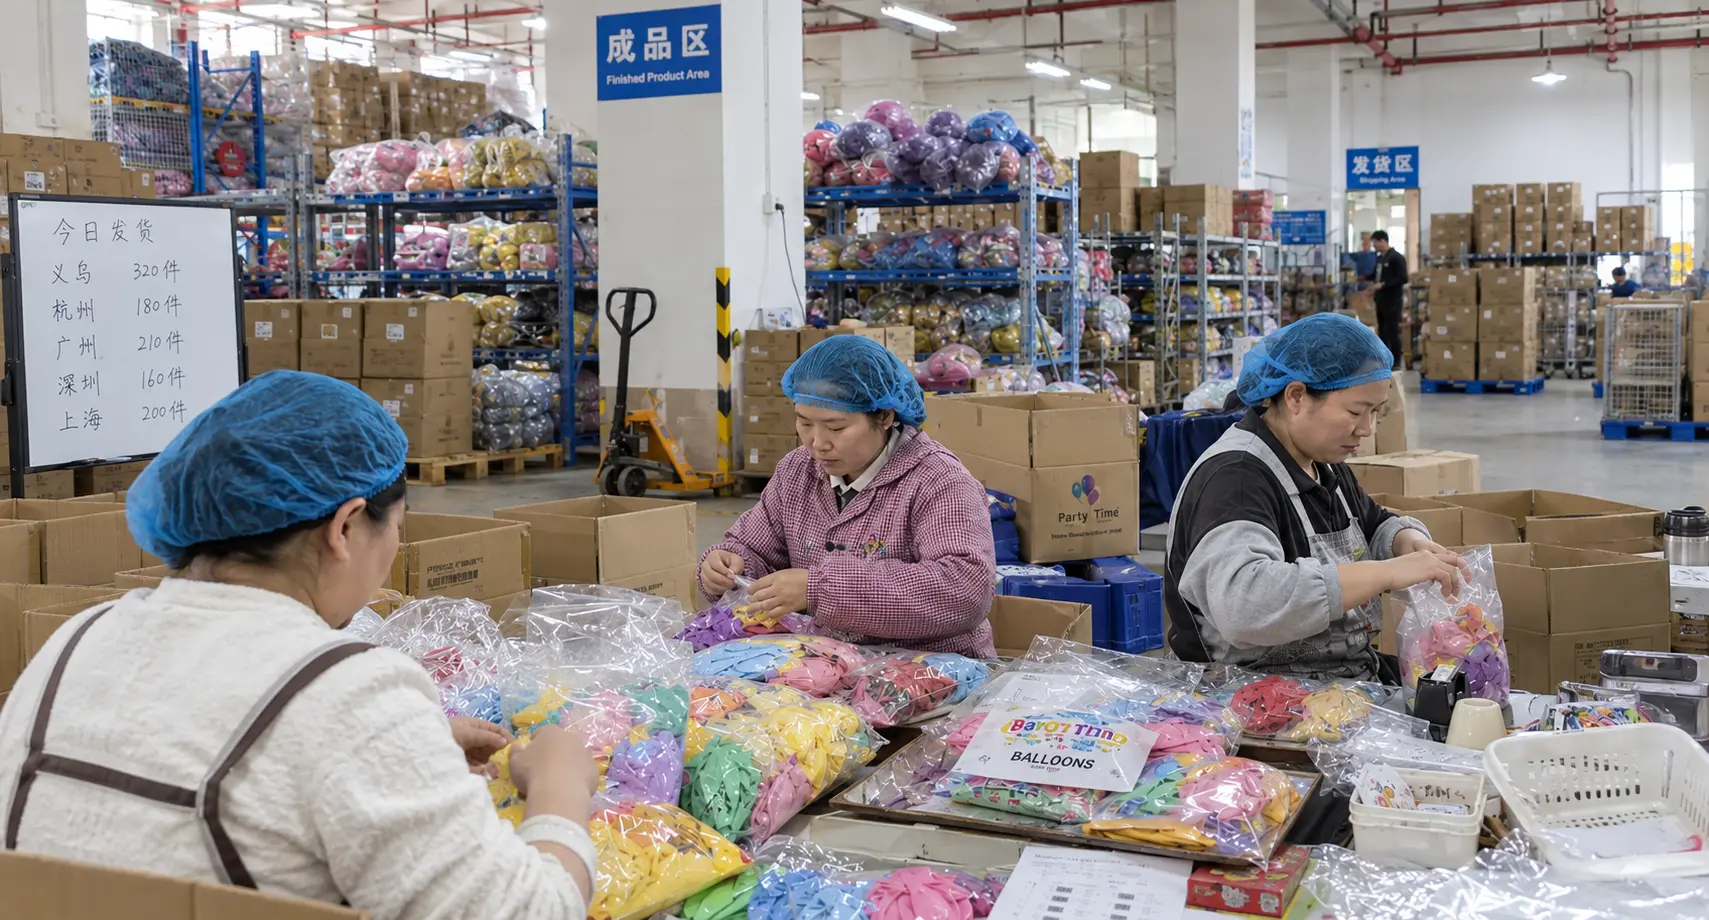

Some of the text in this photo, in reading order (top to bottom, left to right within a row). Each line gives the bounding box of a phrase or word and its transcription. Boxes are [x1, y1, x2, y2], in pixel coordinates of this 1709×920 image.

[606, 24, 710, 64] 成品区
[606, 69, 710, 85] Finished Product Area
[1352, 154, 1414, 175] 发货区
[53, 218, 154, 245] 今日发货
[52, 260, 91, 284] 义乌
[52, 299, 95, 322] 杭州
[57, 335, 97, 360] 广州
[58, 371, 100, 396] 深圳
[60, 408, 103, 432] 上海
[1058, 512, 1088, 524] Party
[1094, 508, 1119, 519] Time
[1010, 751, 1095, 770] BALLOONS
